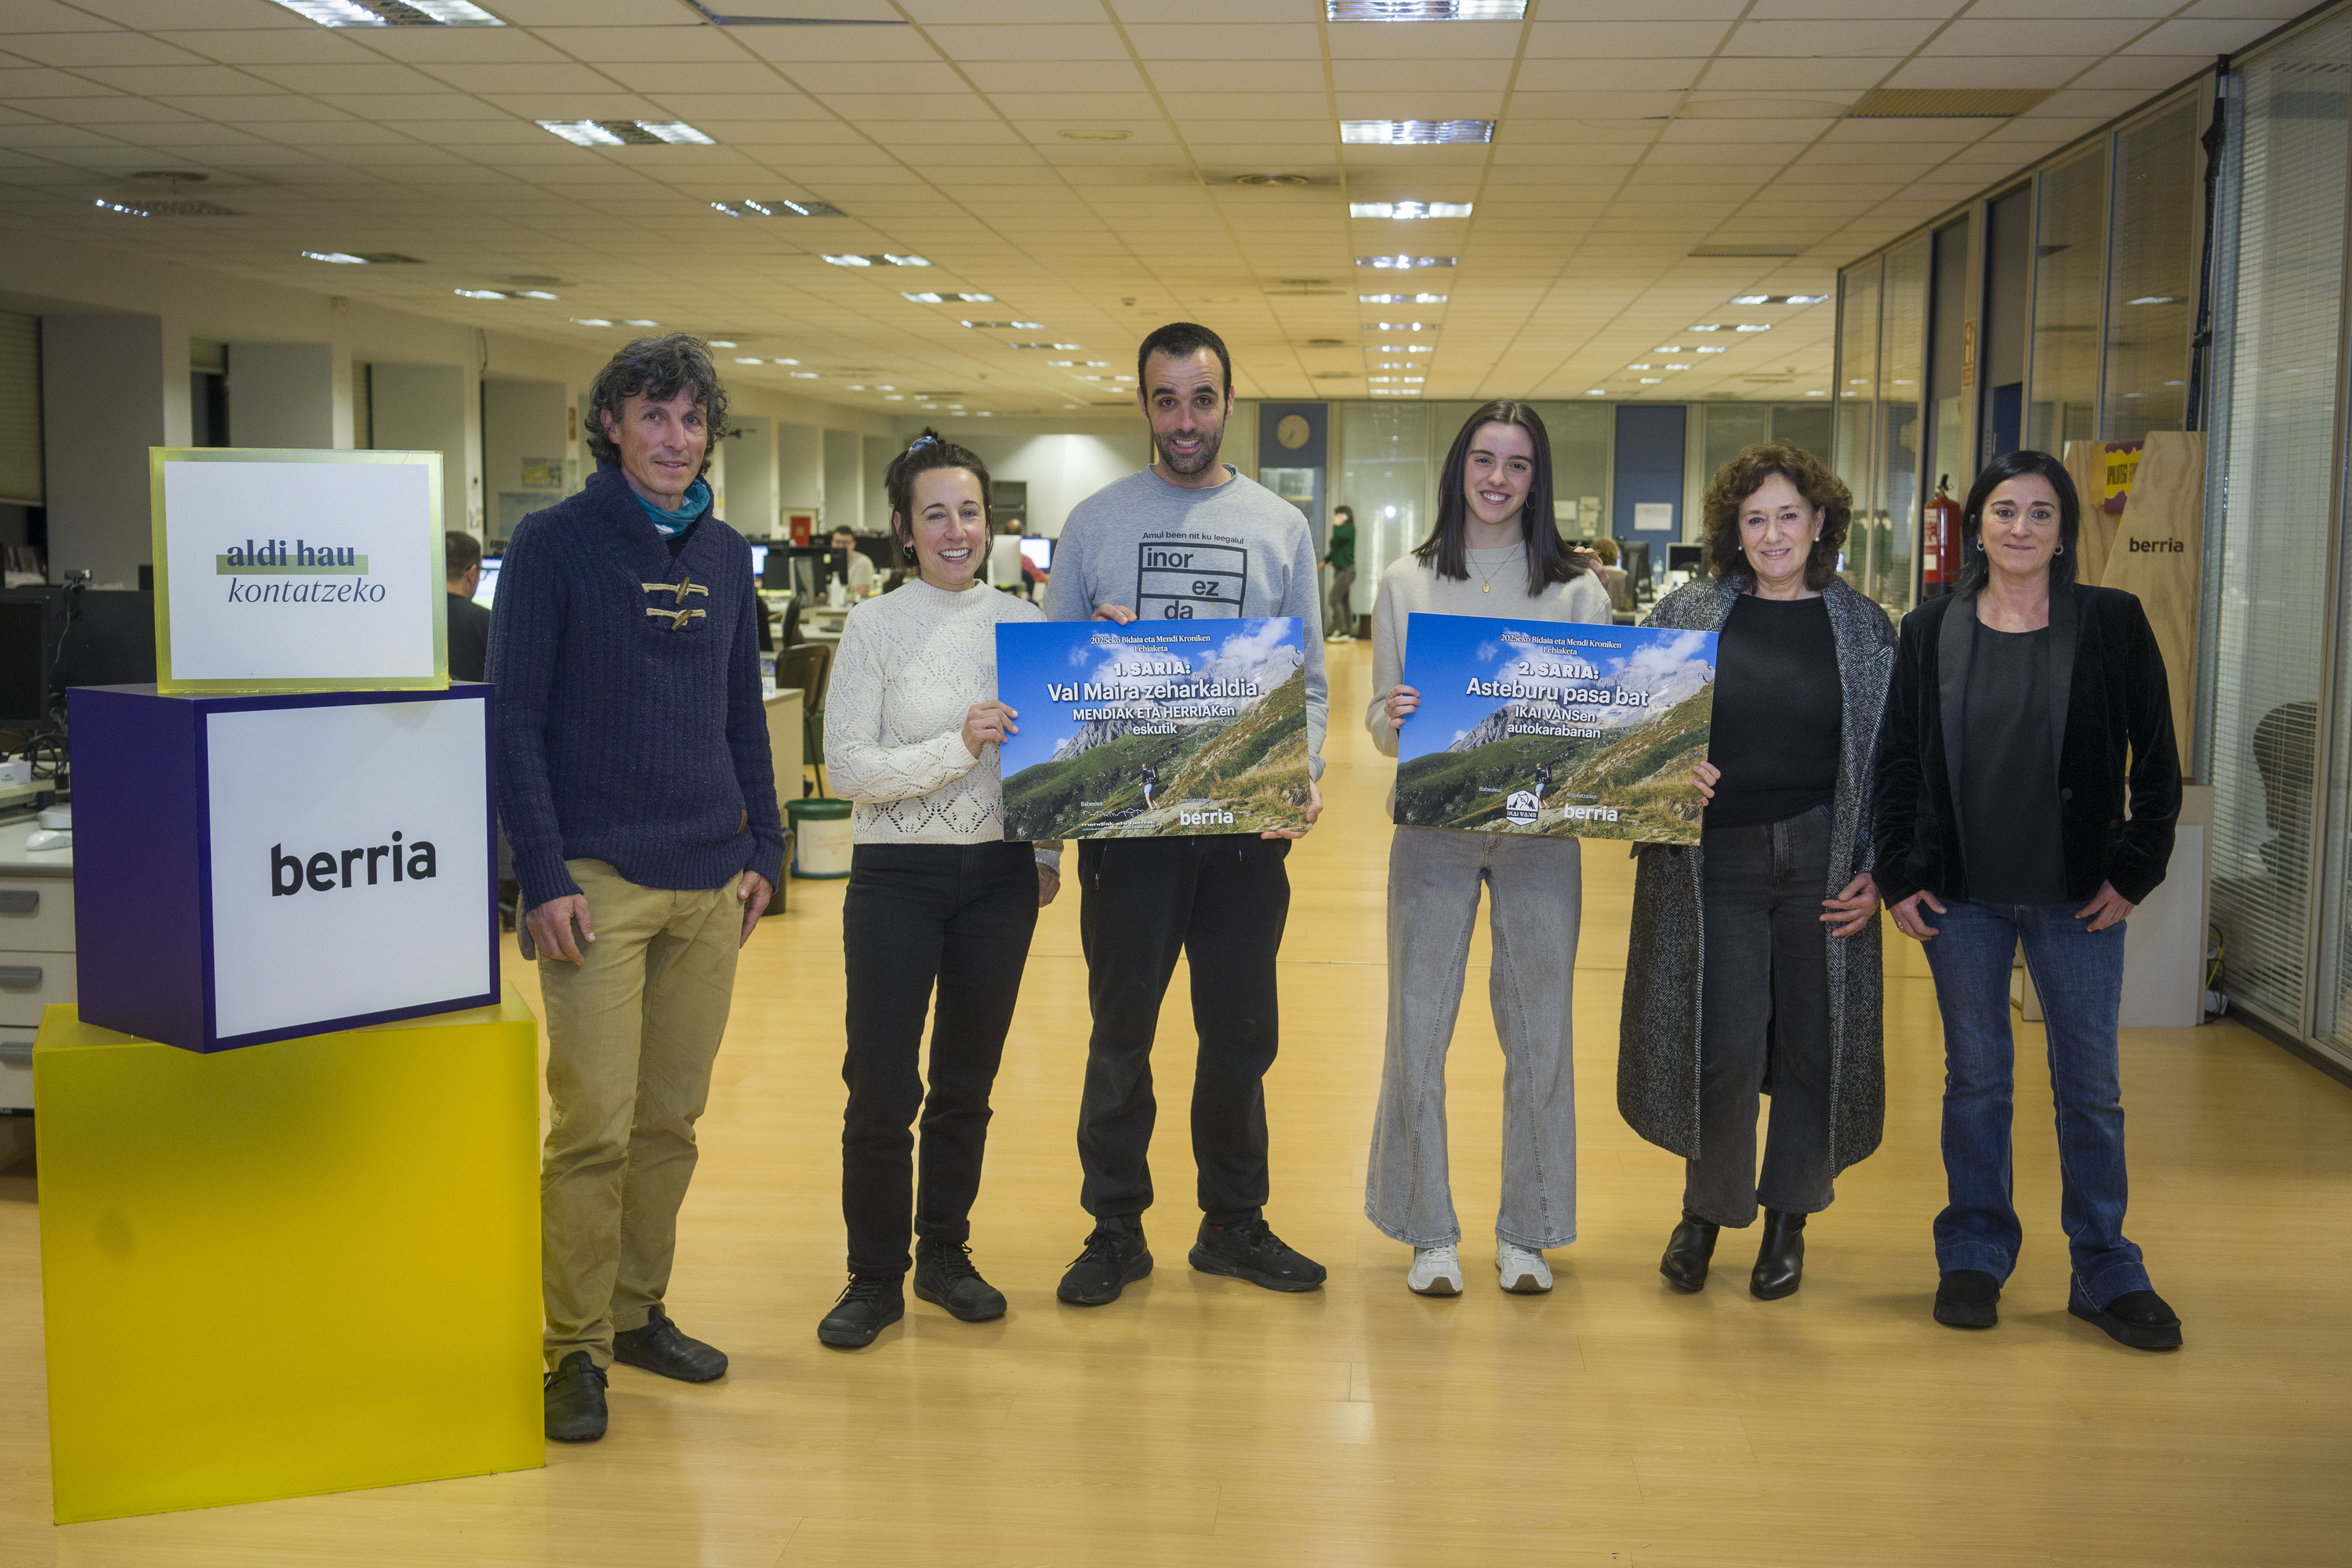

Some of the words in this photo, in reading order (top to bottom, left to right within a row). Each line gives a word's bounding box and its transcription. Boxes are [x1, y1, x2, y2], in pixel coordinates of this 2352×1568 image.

[1214, 534, 1243, 544] leegalul
[2129, 537, 2184, 553] berria
[227, 539, 288, 566] aldi
[296, 539, 355, 566] hau
[1147, 547, 1194, 568] inor
[228, 577, 386, 603] kontatzeko
[1192, 579, 1219, 597] ez
[1163, 600, 1193, 620] da
[1091, 636, 1120, 644] 2025eko
[1121, 635, 1143, 644] Bidaia
[1156, 634, 1178, 643] Mendi
[1179, 634, 1210, 643] Kroniken
[1501, 633, 1530, 643] 2025eko
[1532, 636, 1553, 644] Bidaia
[1566, 638, 1588, 647] Mendi
[1589, 640, 1622, 648] Kroniken
[1543, 646, 1577, 655] Lehiaketa
[1113, 662, 1127, 677] 1.
[1130, 661, 1191, 676] SARIA:
[1519, 661, 1535, 676] 2.
[1537, 662, 1600, 680] SARIA:
[1047, 682, 1079, 702] Val
[1083, 681, 1140, 701] Maira
[1144, 677, 1258, 699] zeharkaldia
[1466, 677, 1559, 700] Asteburu
[1563, 687, 1610, 706] pasa
[1615, 685, 1649, 706] bat
[1073, 706, 1134, 720] MENDIAK
[1137, 706, 1162, 719] ETA
[1163, 705, 1236, 718] HERRIAKen
[1515, 706, 1541, 719] IKAI
[1544, 709, 1596, 722] VANSen
[1133, 722, 1178, 735] eskutik
[1507, 722, 1601, 739] autokarabanan
[1180, 808, 1234, 826] berria
[1564, 803, 1618, 822] berria
[270, 830, 437, 897] berria
